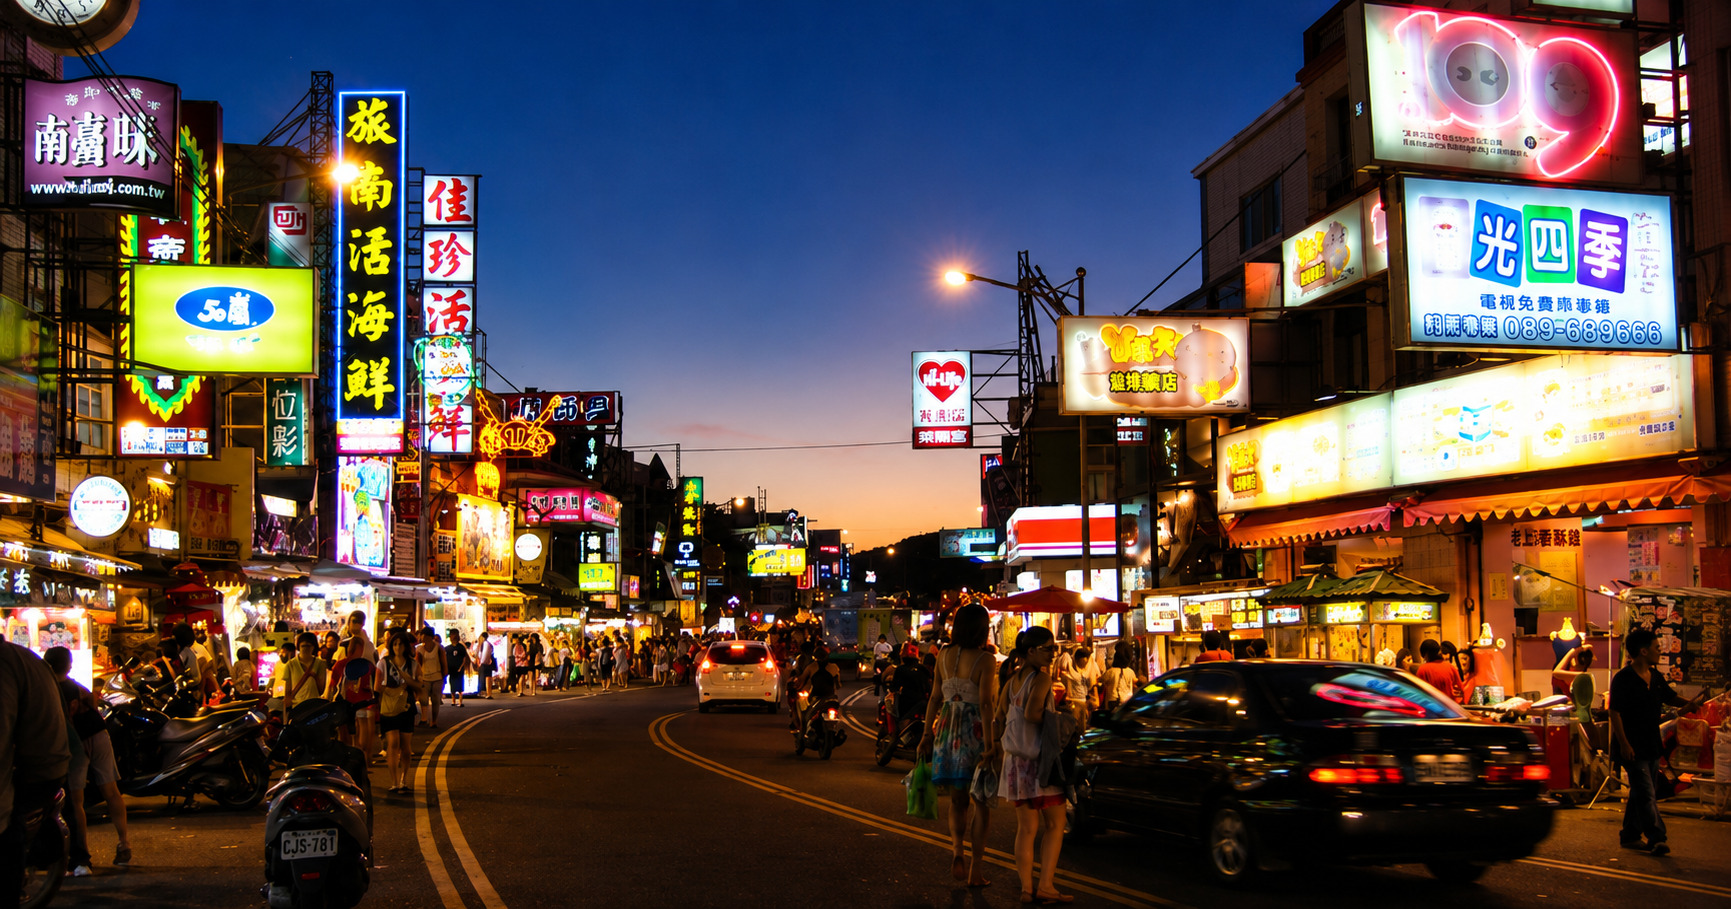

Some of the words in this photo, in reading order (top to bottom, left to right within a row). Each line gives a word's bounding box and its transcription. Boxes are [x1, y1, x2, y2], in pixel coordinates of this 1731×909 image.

[345, 97, 397, 411] 旅南活海鮮
[427, 177, 472, 452] 佳珍活鮮
[1503, 316, 1663, 345] 089-689666
[283, 836, 336, 855] CJS-781
